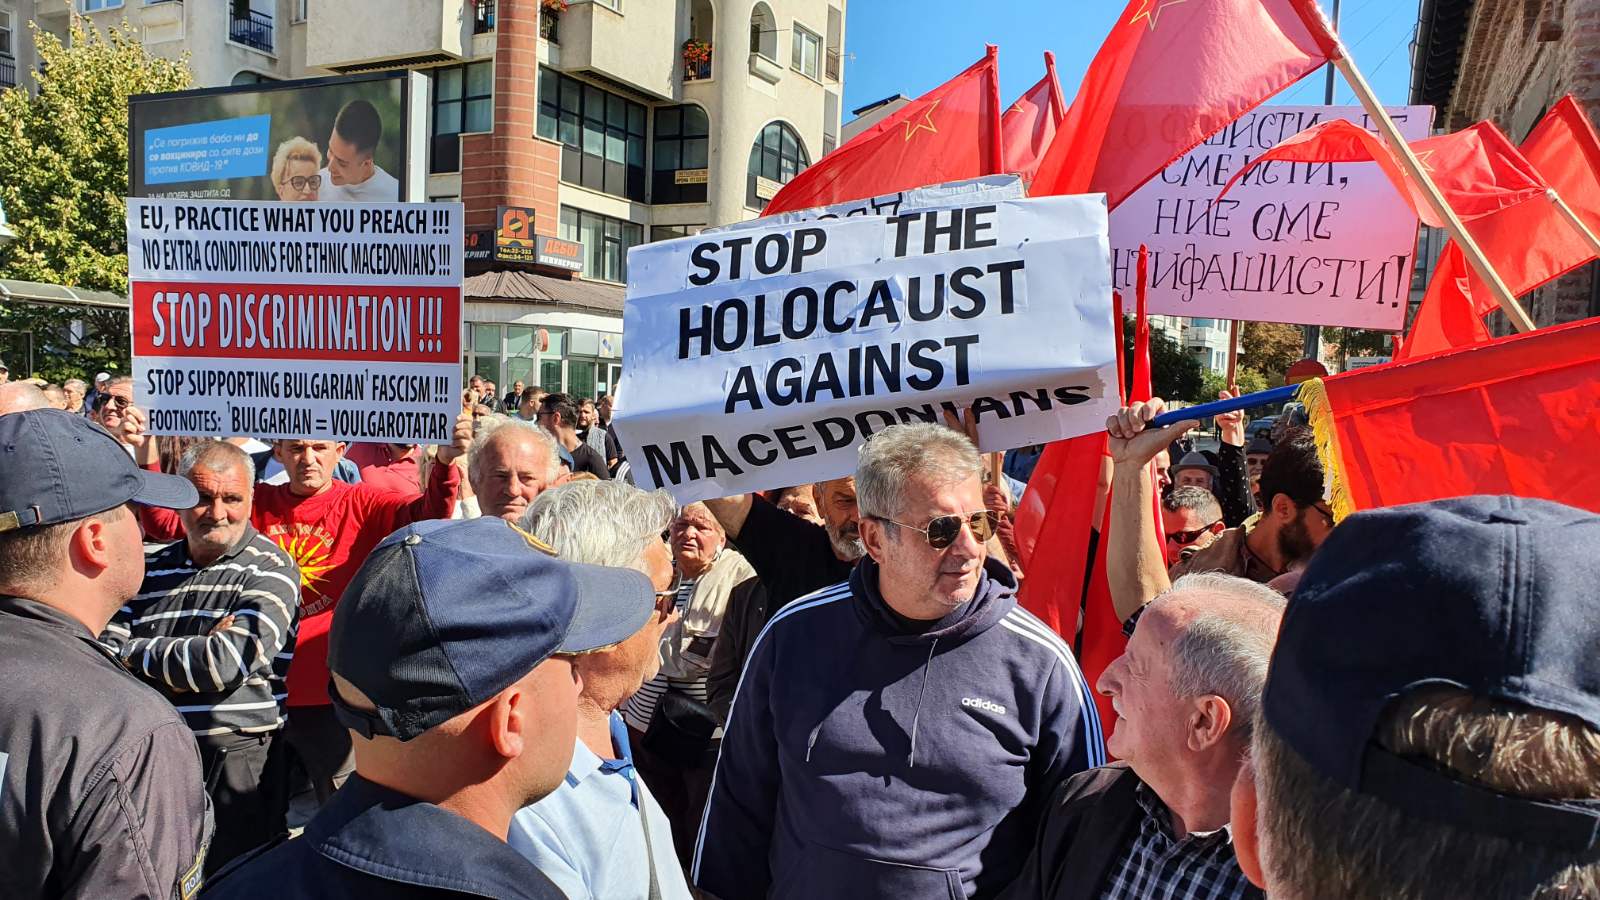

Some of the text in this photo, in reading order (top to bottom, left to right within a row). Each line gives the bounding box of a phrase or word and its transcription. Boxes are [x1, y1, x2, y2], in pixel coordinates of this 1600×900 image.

[161, 150, 208, 161] вакцинира
[209, 134, 232, 144] баба
[246, 132, 259, 142] да
[140, 205, 449, 235] EU, PRACTICE WHAT YOU PREACH !!!
[1154, 199, 1340, 242] НИЕ СМЕ
[142, 239, 451, 276] NO EXTRA CONDITIONS FOR ETHNIC MACEDONIANS !!!
[688, 227, 827, 287] STOP
[886, 204, 998, 258] THE
[152, 291, 443, 353] STOP DISCRIMINATION !!!
[679, 259, 1025, 360] HOLOCAUST
[147, 369, 184, 395] STOP
[188, 370, 280, 398] SUPPORTING
[372, 375, 431, 402] FASCISM
[434, 376, 449, 403] !!!
[724, 334, 980, 415] AGAINST
[149, 409, 221, 432] FOOTNOTES:
[316, 418, 328, 431] =
[331, 410, 448, 440] VOULGAROTATAR
[961, 697, 1006, 715] adidas
